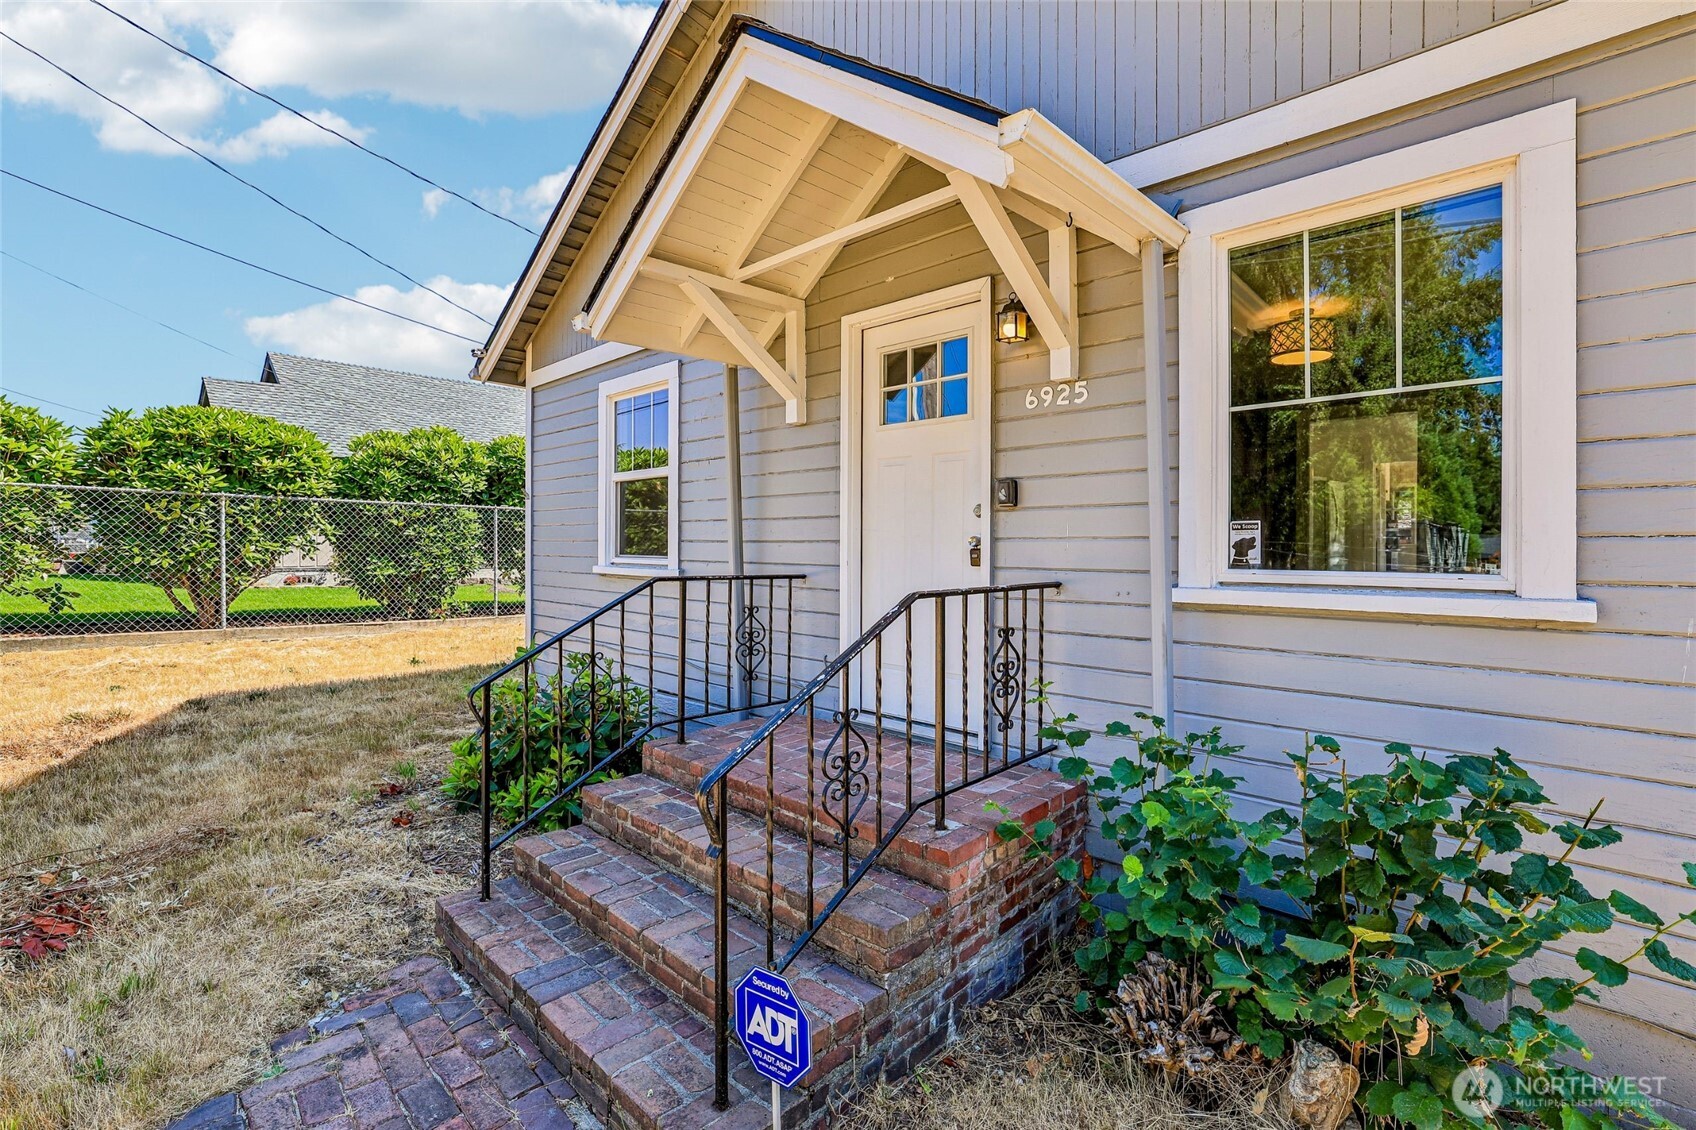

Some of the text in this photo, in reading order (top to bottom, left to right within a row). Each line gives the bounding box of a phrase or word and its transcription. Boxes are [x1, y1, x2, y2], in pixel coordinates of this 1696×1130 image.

[1025, 381, 1088, 409] 6925
[752, 976, 789, 1000] Secured by
[747, 1003, 797, 1054] ADT
